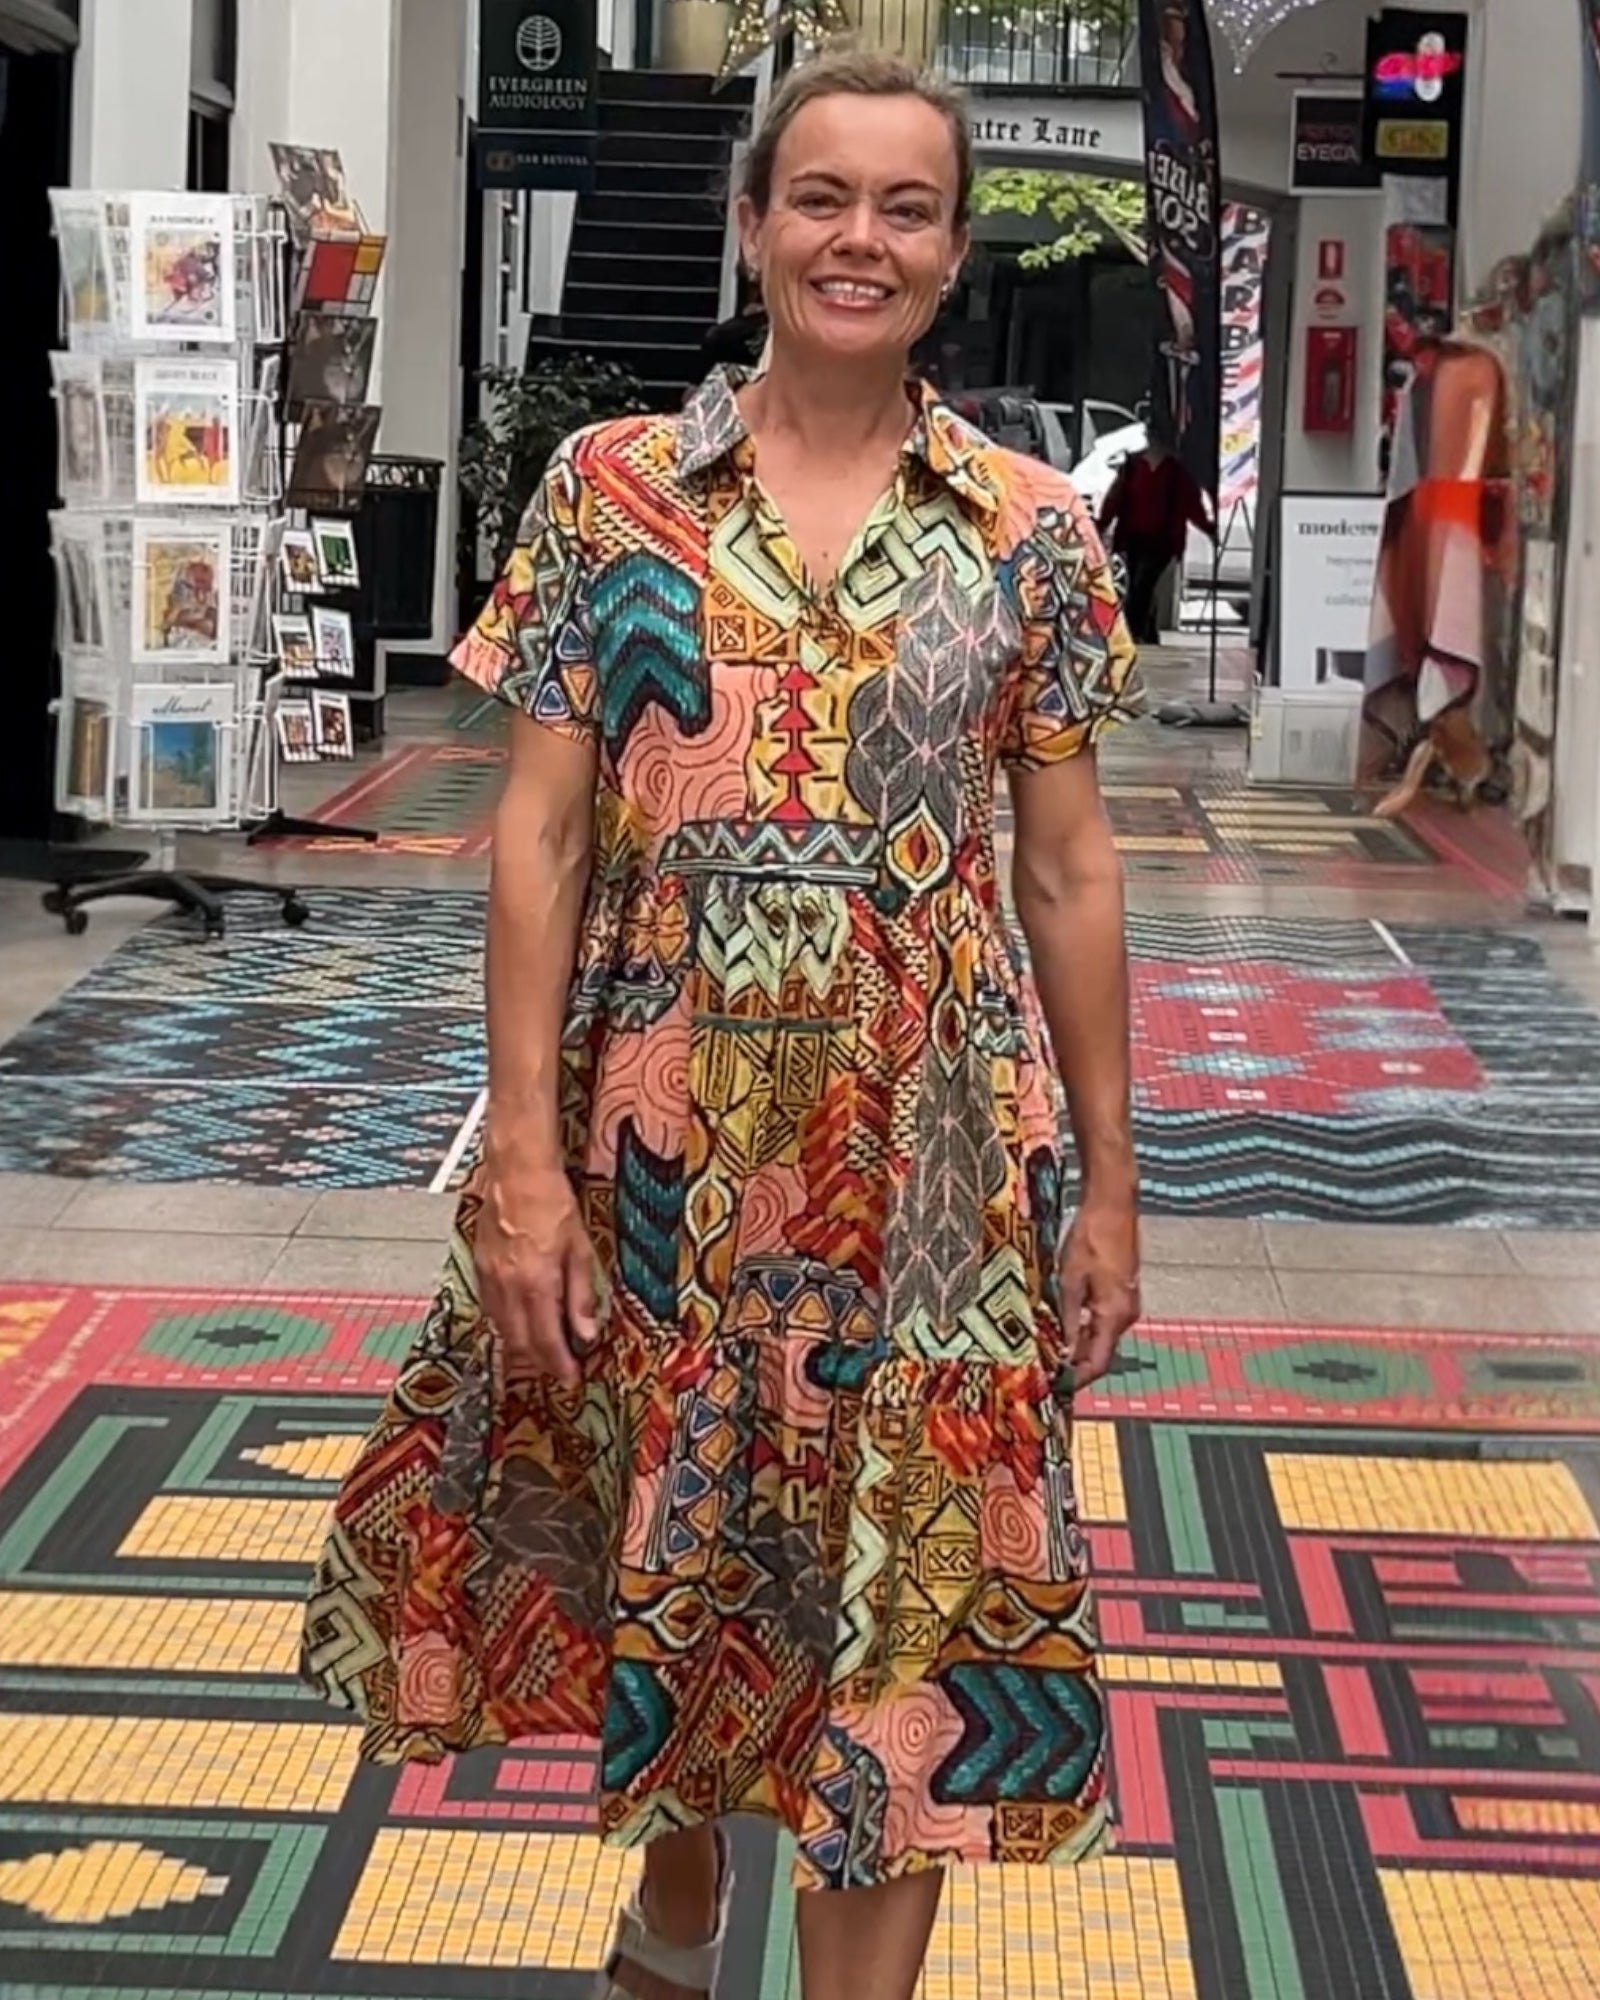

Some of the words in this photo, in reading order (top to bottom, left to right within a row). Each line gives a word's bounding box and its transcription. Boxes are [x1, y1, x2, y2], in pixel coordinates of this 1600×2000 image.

[489, 76, 588, 93] EVERGREEN
[489, 94, 585, 110] AUDIOLOGY
[1032, 116, 1101, 147] Lane
